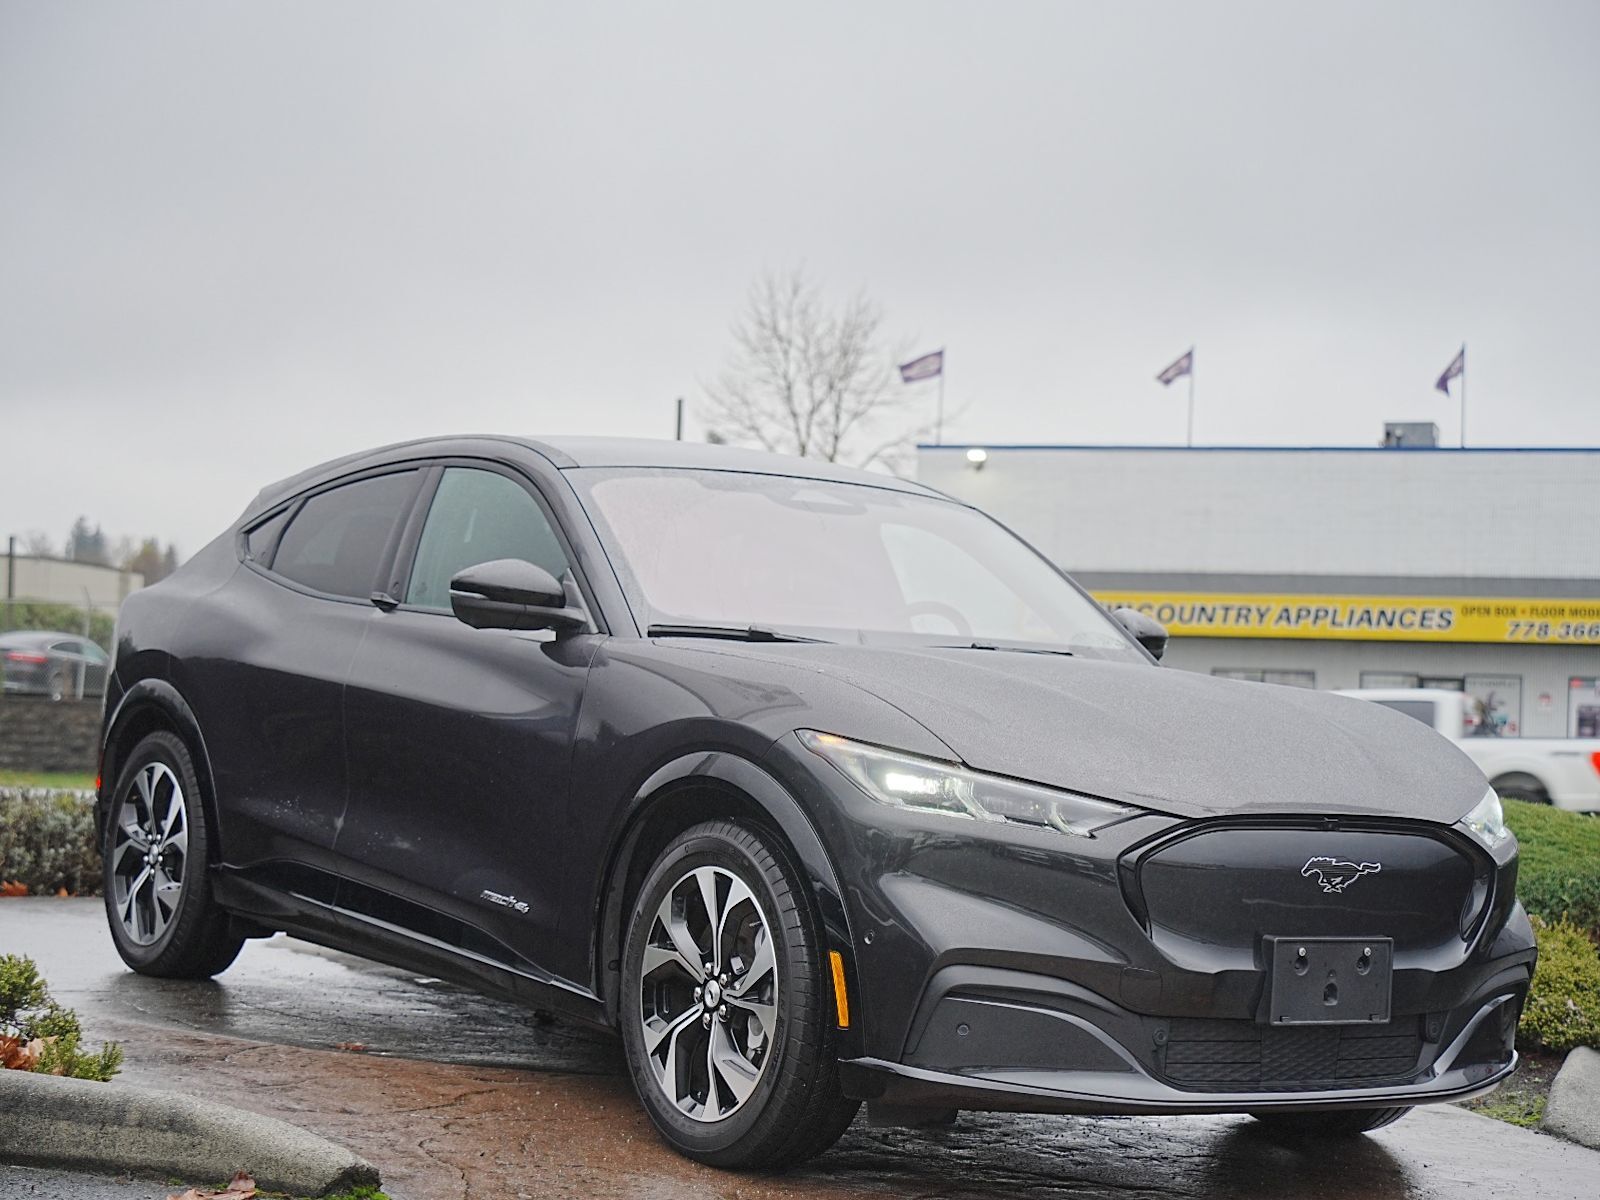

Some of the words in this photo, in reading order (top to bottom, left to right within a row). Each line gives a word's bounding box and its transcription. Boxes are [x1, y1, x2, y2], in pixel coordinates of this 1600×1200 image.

[1273, 605, 1453, 629] APPLIANCES
[1461, 605, 1491, 617] OPEN
[1495, 606, 1517, 617] BOX
[1530, 606, 1565, 618] FLOOR
